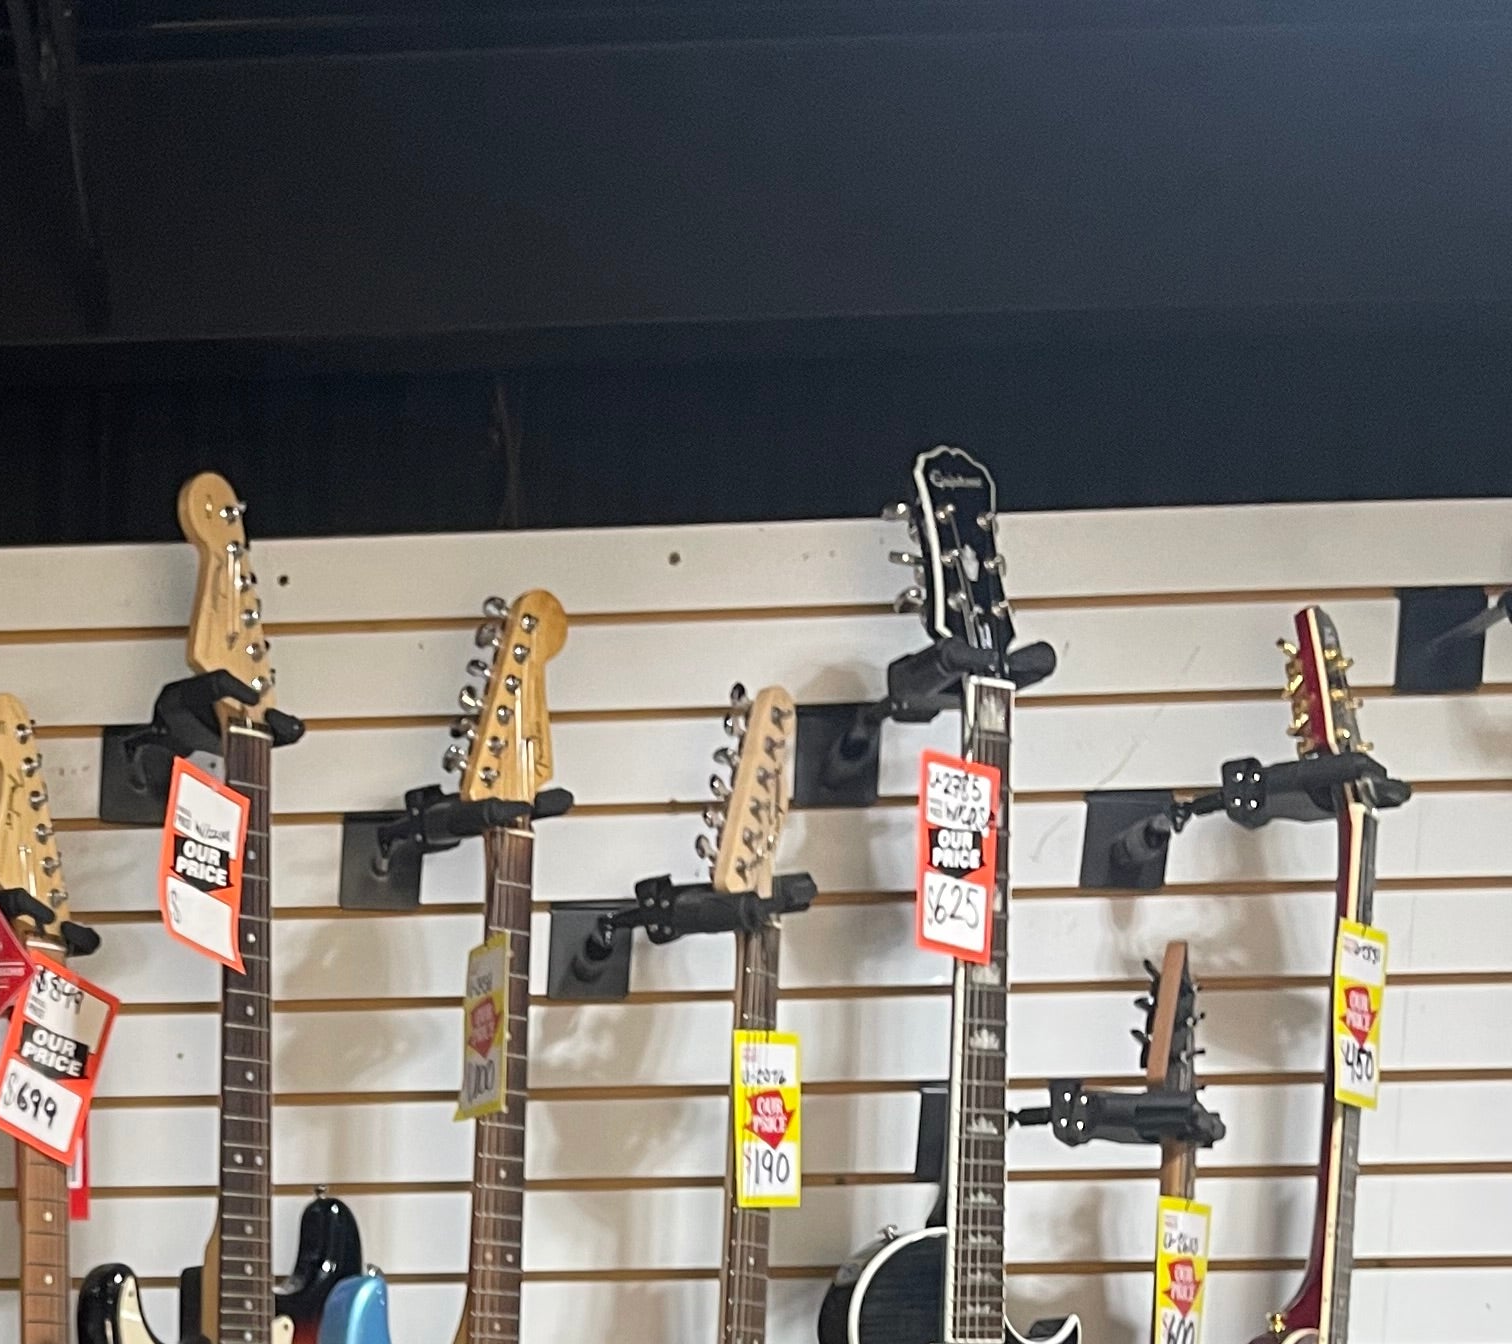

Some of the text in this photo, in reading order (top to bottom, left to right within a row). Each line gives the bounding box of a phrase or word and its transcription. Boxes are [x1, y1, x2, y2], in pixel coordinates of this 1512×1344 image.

[937, 829, 974, 849] OUR
[182, 840, 222, 867] OUR
[931, 846, 982, 870] PRICE
[175, 855, 228, 887] PRICE
[31, 1027, 79, 1058] OUR
[20, 1039, 84, 1078] PRICE
[755, 1095, 785, 1116] OUR
[751, 1112, 788, 1134] PRICE
